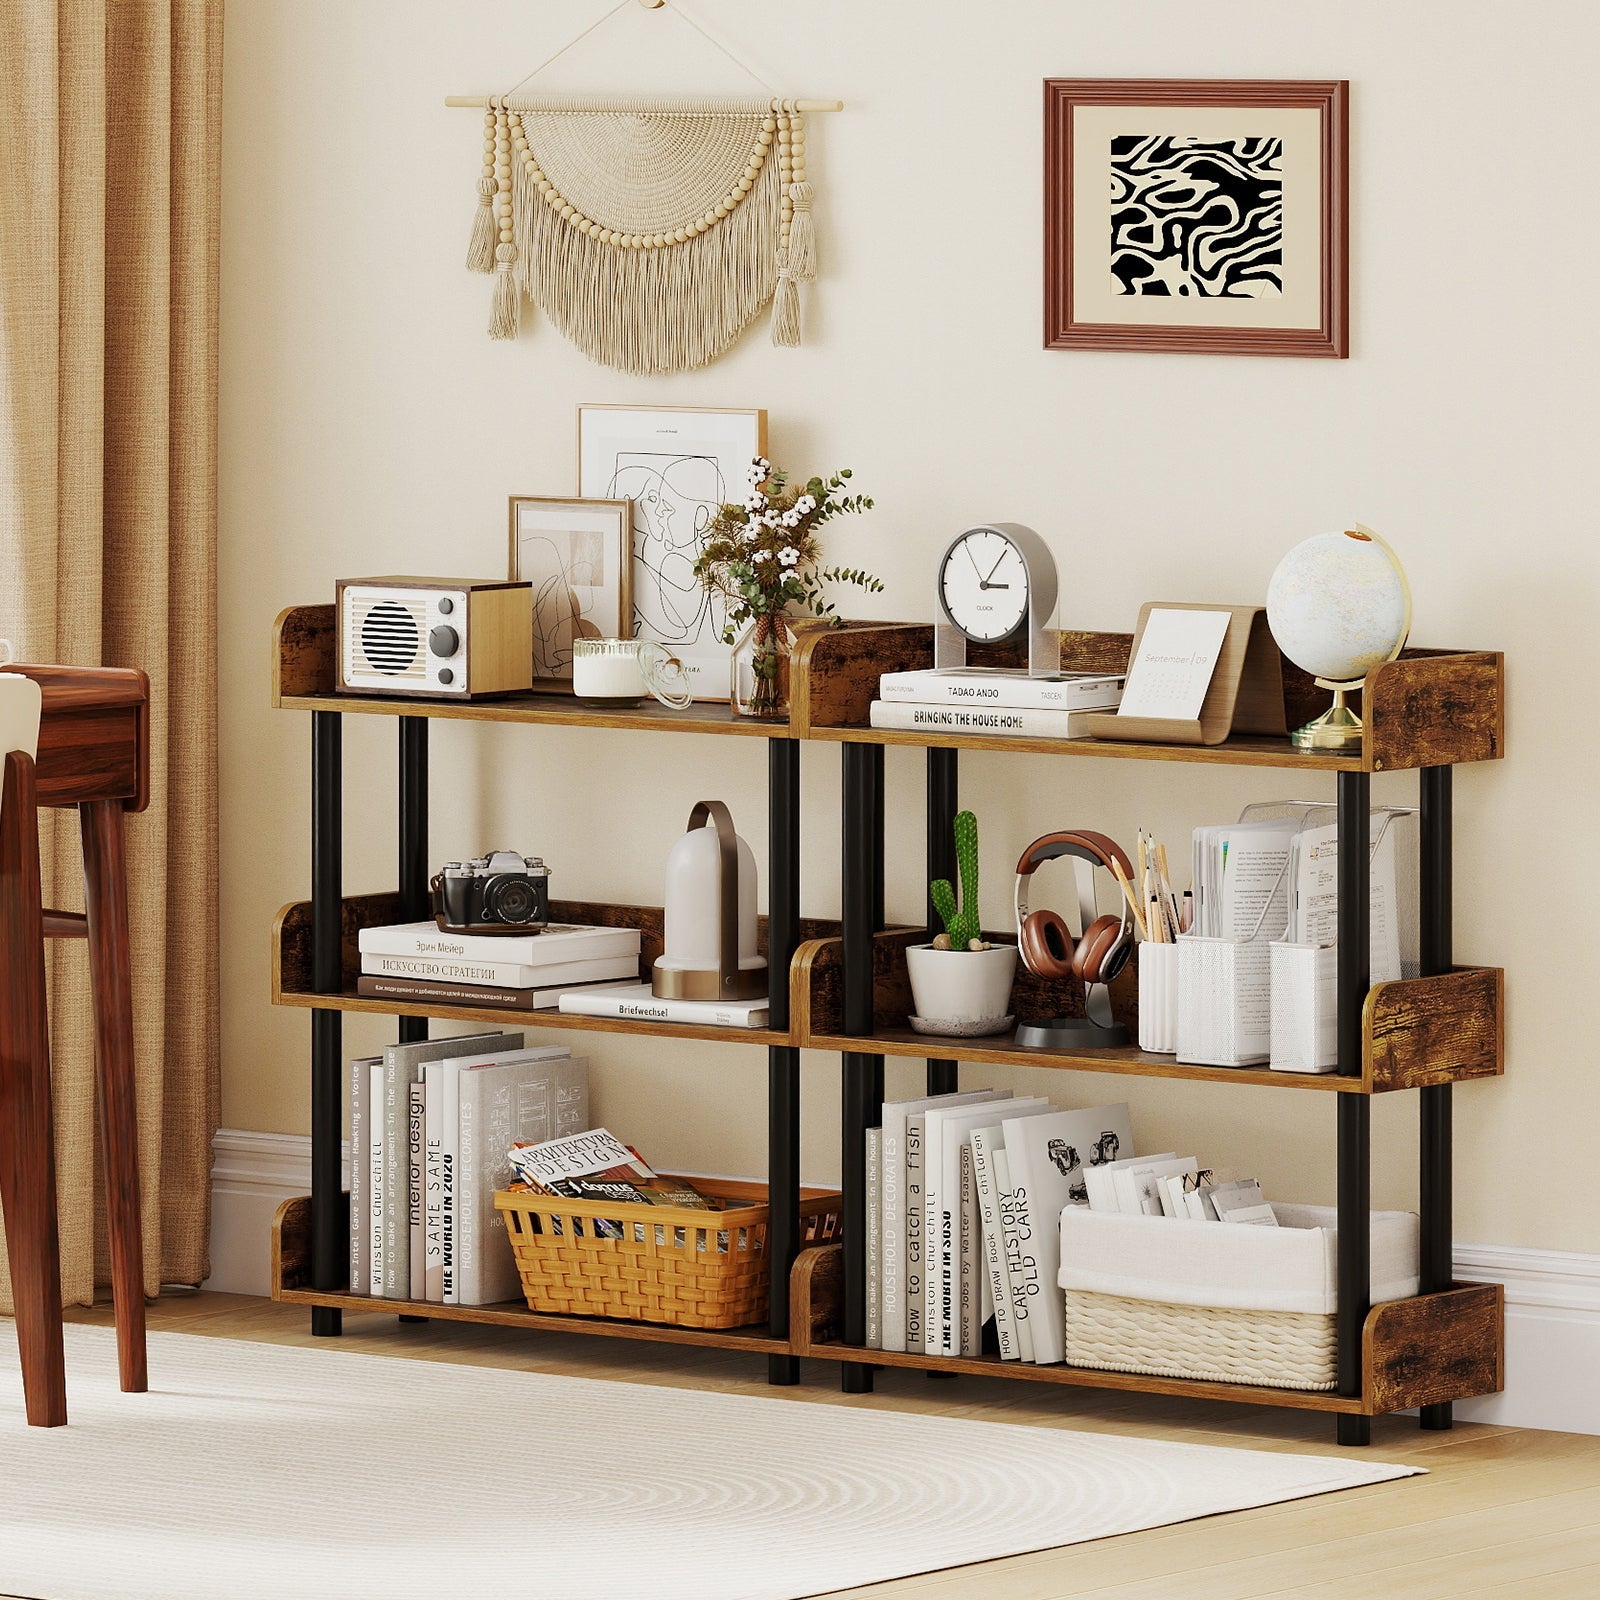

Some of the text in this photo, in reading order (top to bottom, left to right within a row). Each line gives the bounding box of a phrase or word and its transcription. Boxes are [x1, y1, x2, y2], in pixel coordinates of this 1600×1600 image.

[948, 687, 999, 699] TADAO ANDO
[914, 710, 1023, 729] BRINGING THE HOUSE HOME
[416, 940, 465, 956] Эрин Мейер
[382, 960, 496, 980] ИСКУССТВО СТРАТЕГИИ
[619, 1005, 668, 1017] Briefwechsel
[352, 1113, 361, 1154] Hawking
[521, 1132, 619, 1165] АРХИТЕКТУРА
[387, 1053, 397, 1288] How to make an arrangement in the house
[411, 1092, 423, 1226] Interior design
[537, 1144, 628, 1176] DESIGN
[352, 1160, 361, 1200] Stephen
[428, 1139, 440, 1255] SAME SAME
[462, 1103, 471, 1268] HOUSEHOLD DECORATES
[580, 1179, 634, 1192] domus
[869, 1187, 876, 1197] in
[373, 1142, 381, 1284] Winston Churchill
[444, 1154, 452, 1296] THE WORLD IN 2020
[886, 1138, 896, 1312] HOUSEHOLD DECORATES
[908, 1128, 920, 1342] How to catch a fish
[973, 1135, 1010, 1354] HOW TO DRAW Book for children
[1013, 1188, 1039, 1296] OLD CARS
[870, 1266, 876, 1276] an
[927, 1192, 935, 1343] Winston Churchill
[962, 1261, 970, 1274] by
[999, 1192, 1028, 1320] CAR HISTORY
[870, 1308, 876, 1318] to
